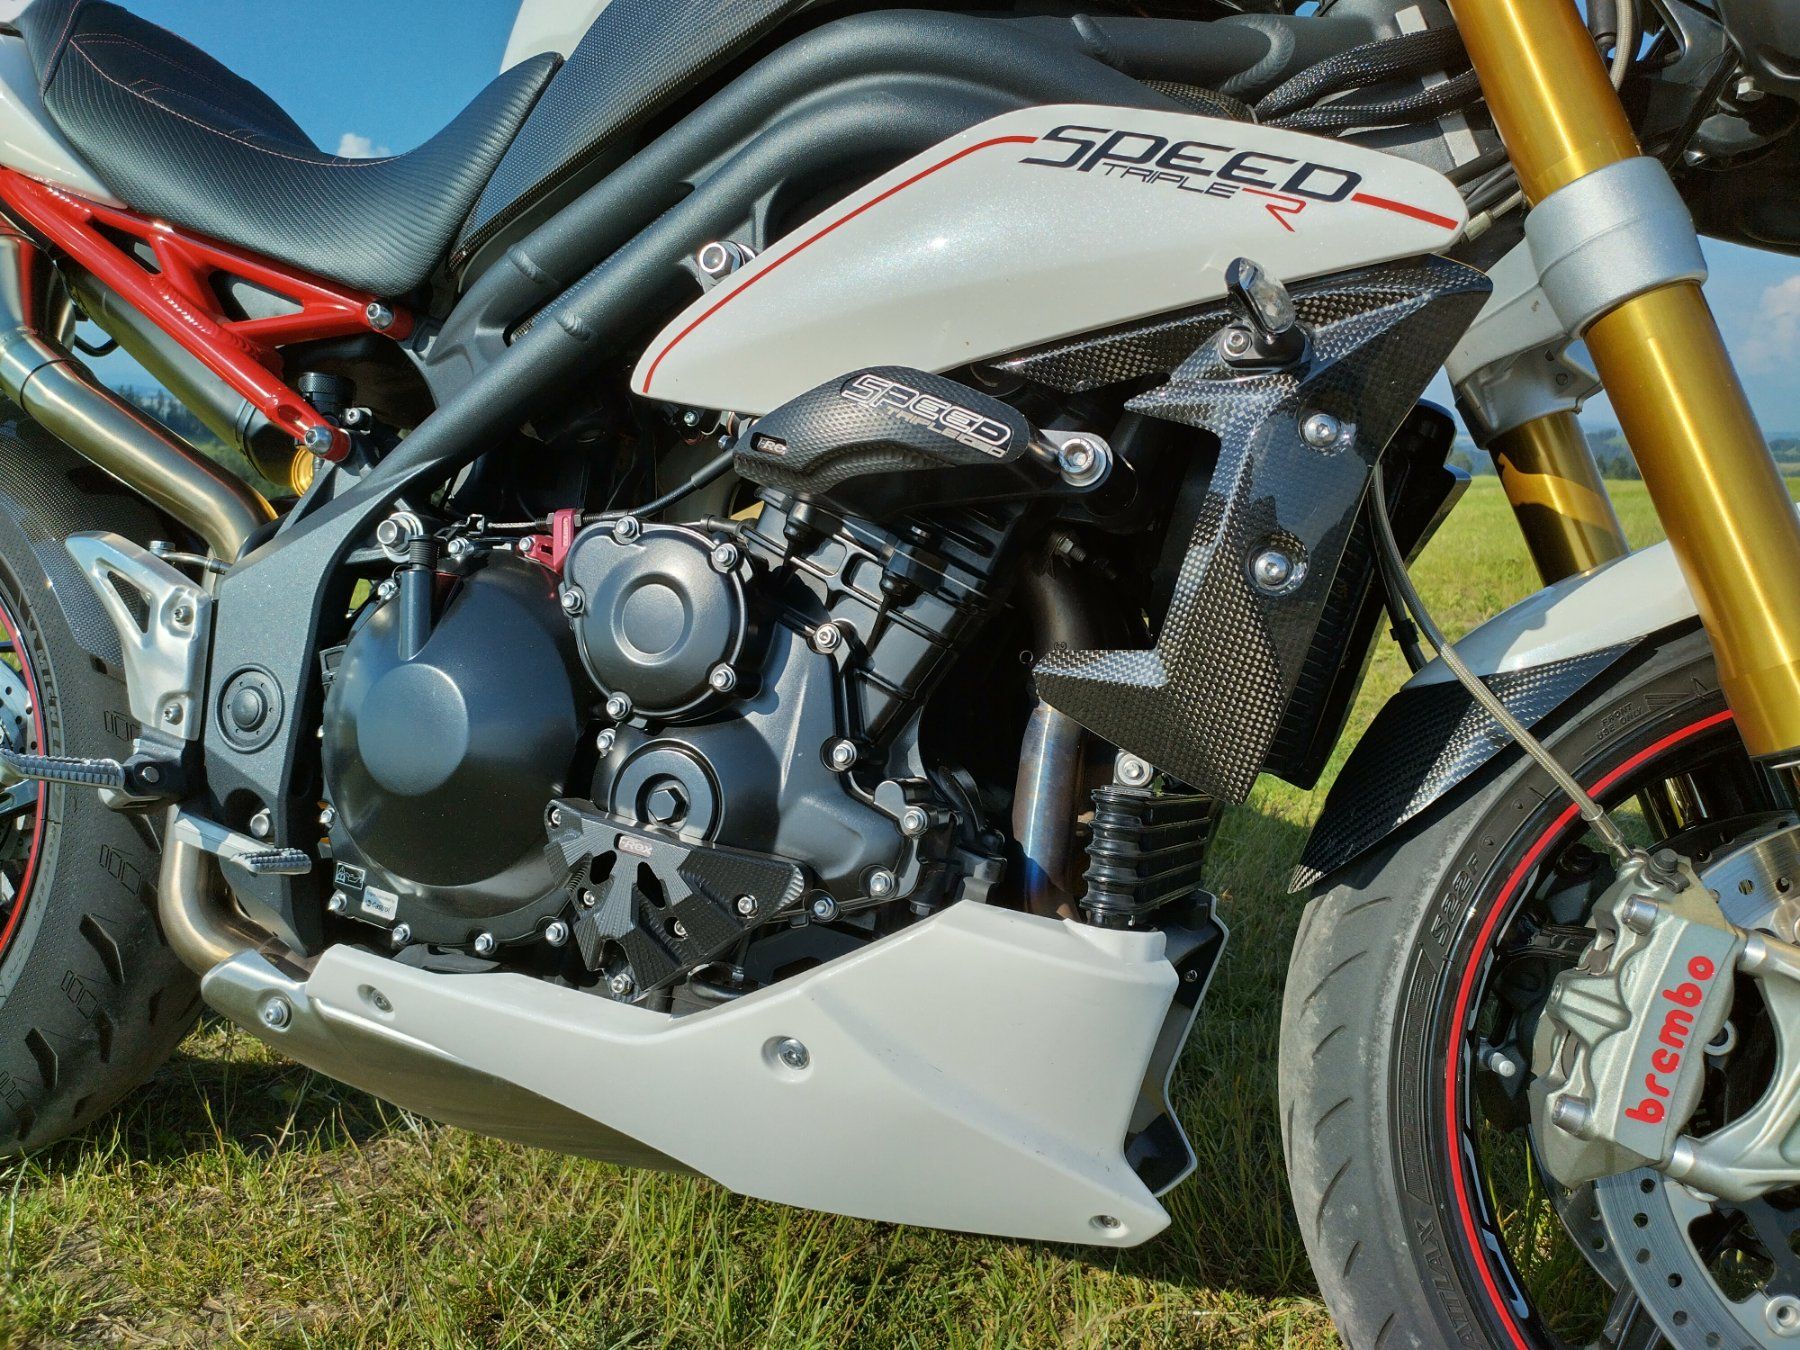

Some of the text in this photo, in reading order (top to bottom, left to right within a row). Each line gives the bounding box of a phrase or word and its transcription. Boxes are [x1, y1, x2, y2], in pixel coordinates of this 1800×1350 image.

[1018, 125, 1363, 203] SPEED
[1101, 161, 1307, 233] TRIPLE R
[840, 373, 1012, 446] SPEED
[1600, 702, 1632, 729] FRONT
[1624, 955, 1716, 1125] brembo
[1414, 1218, 1486, 1350] ATTLAX
